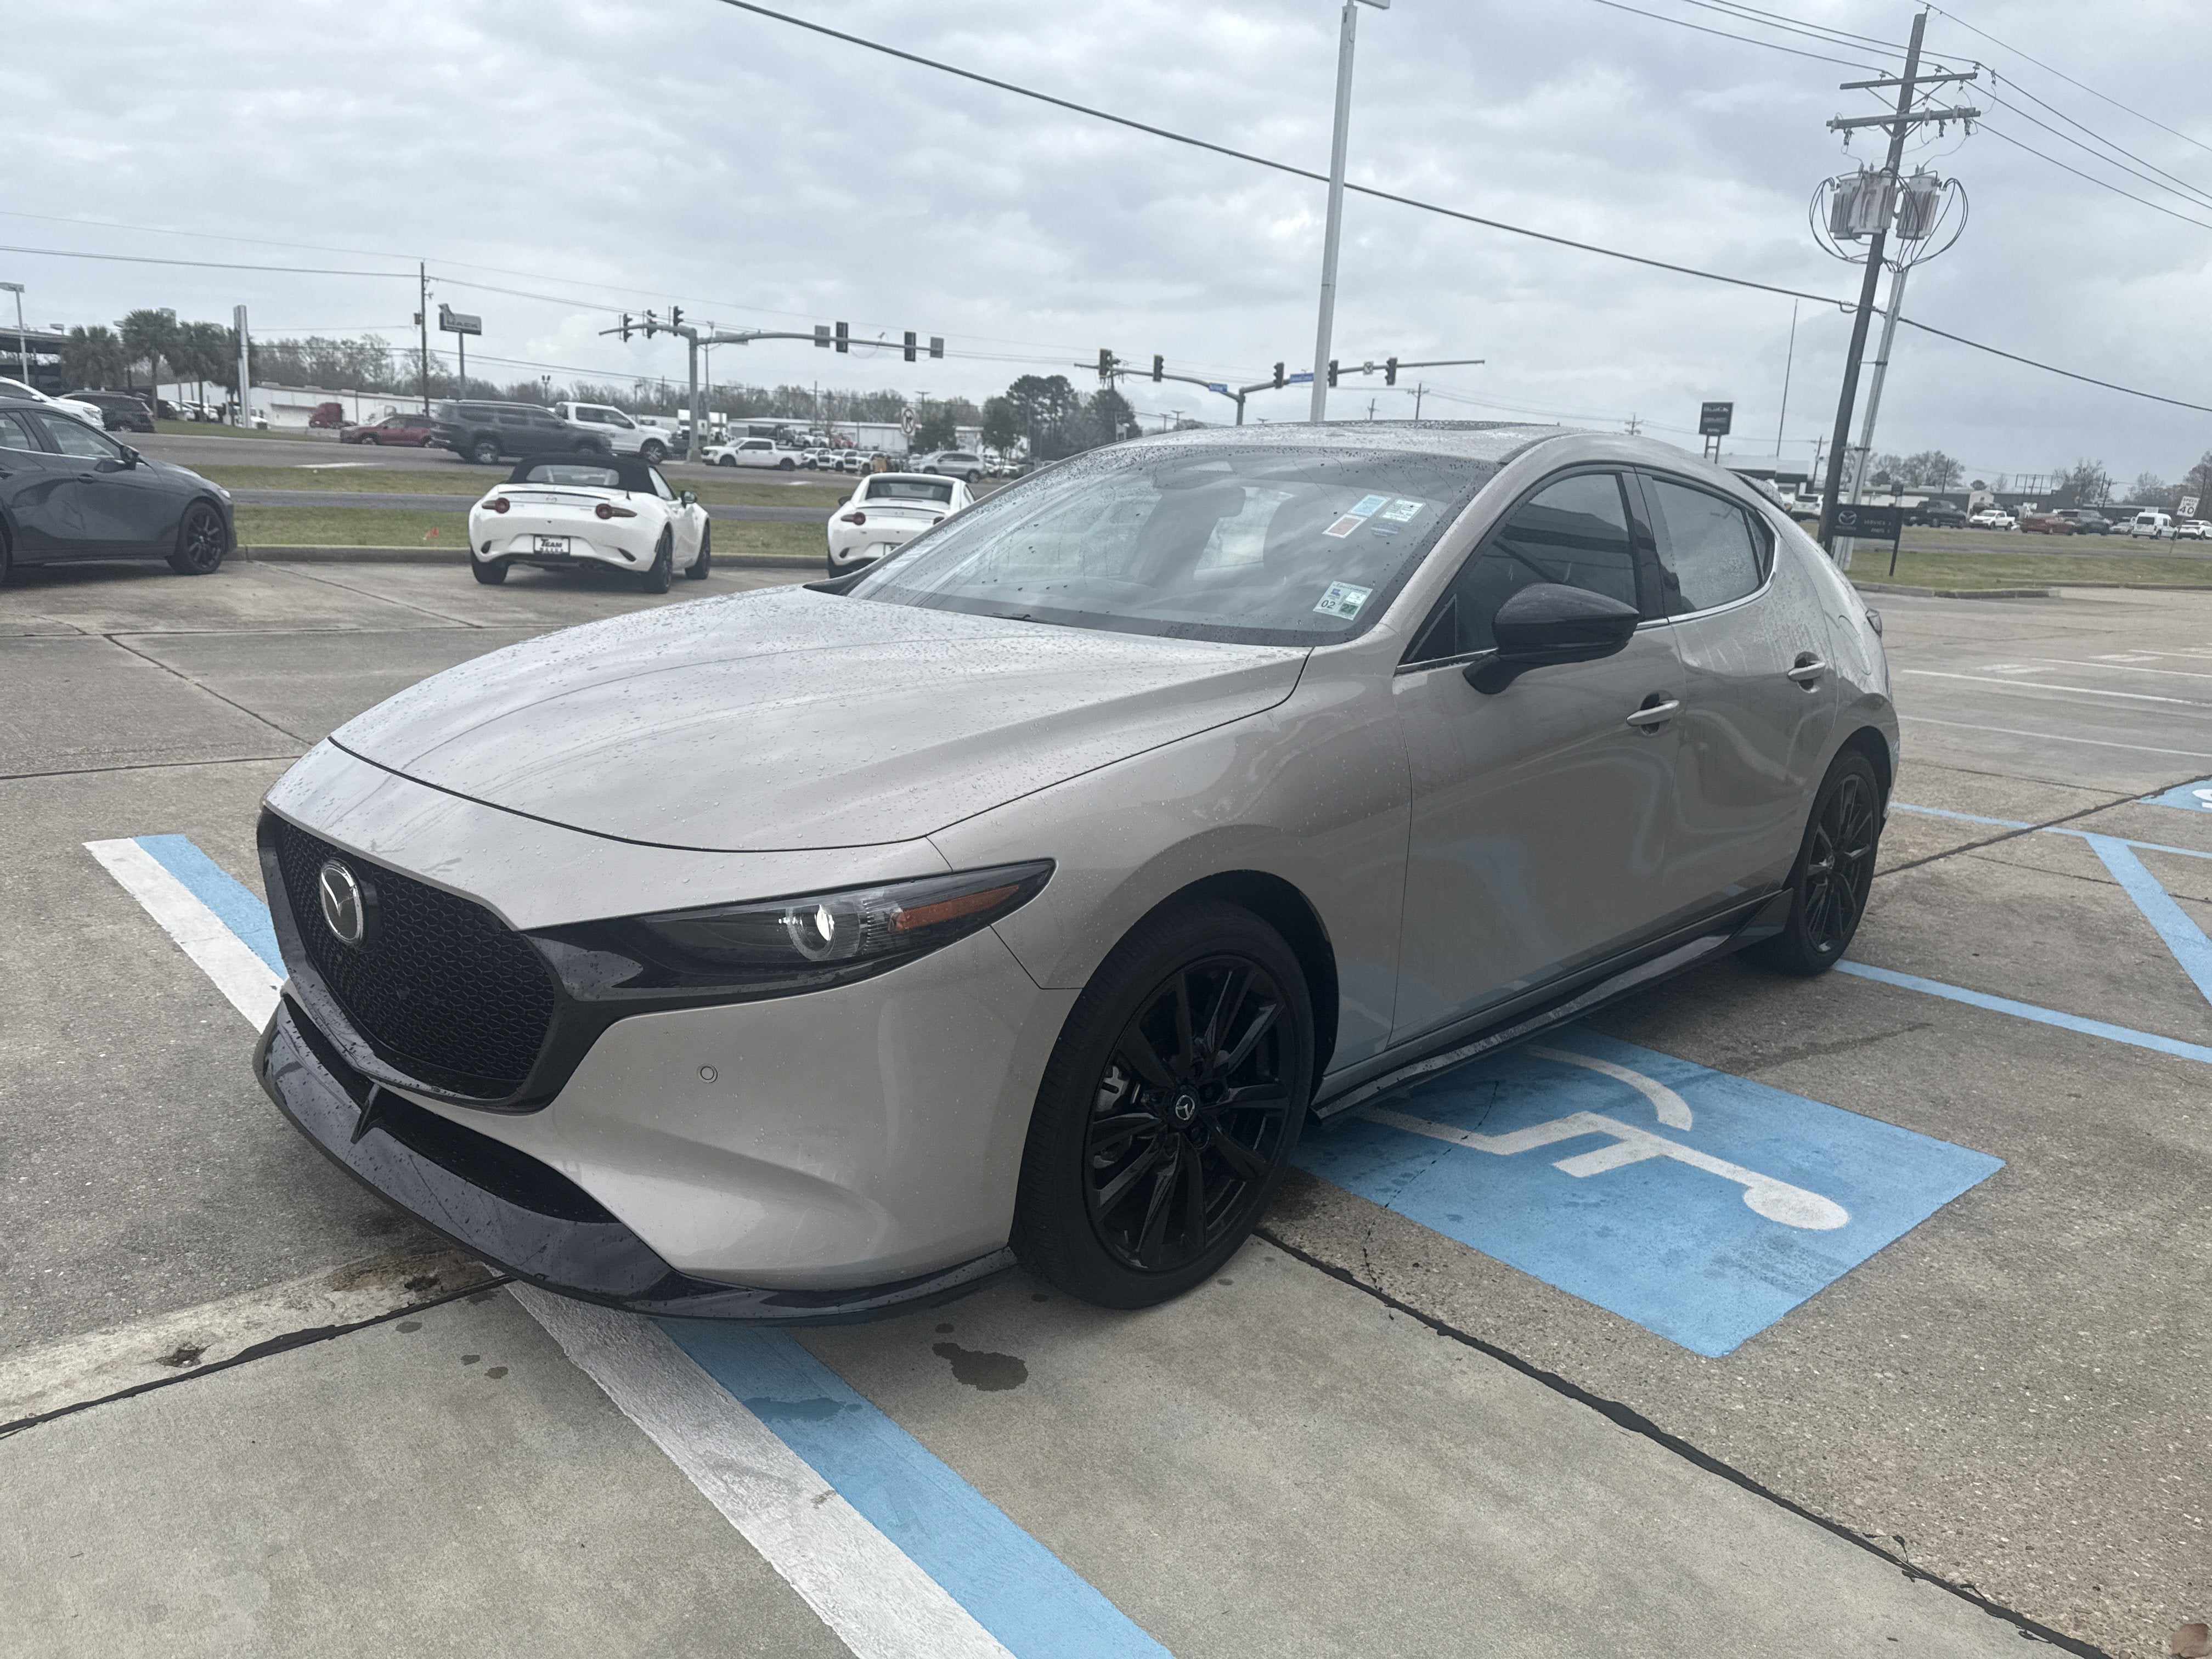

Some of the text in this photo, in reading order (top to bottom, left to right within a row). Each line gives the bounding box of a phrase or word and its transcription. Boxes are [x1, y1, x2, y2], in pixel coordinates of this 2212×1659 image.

[2179, 506, 2194, 514] 40
[540, 538, 562, 548] TEAM
[1321, 600, 1336, 609] 02
[1340, 603, 1357, 613] 27
